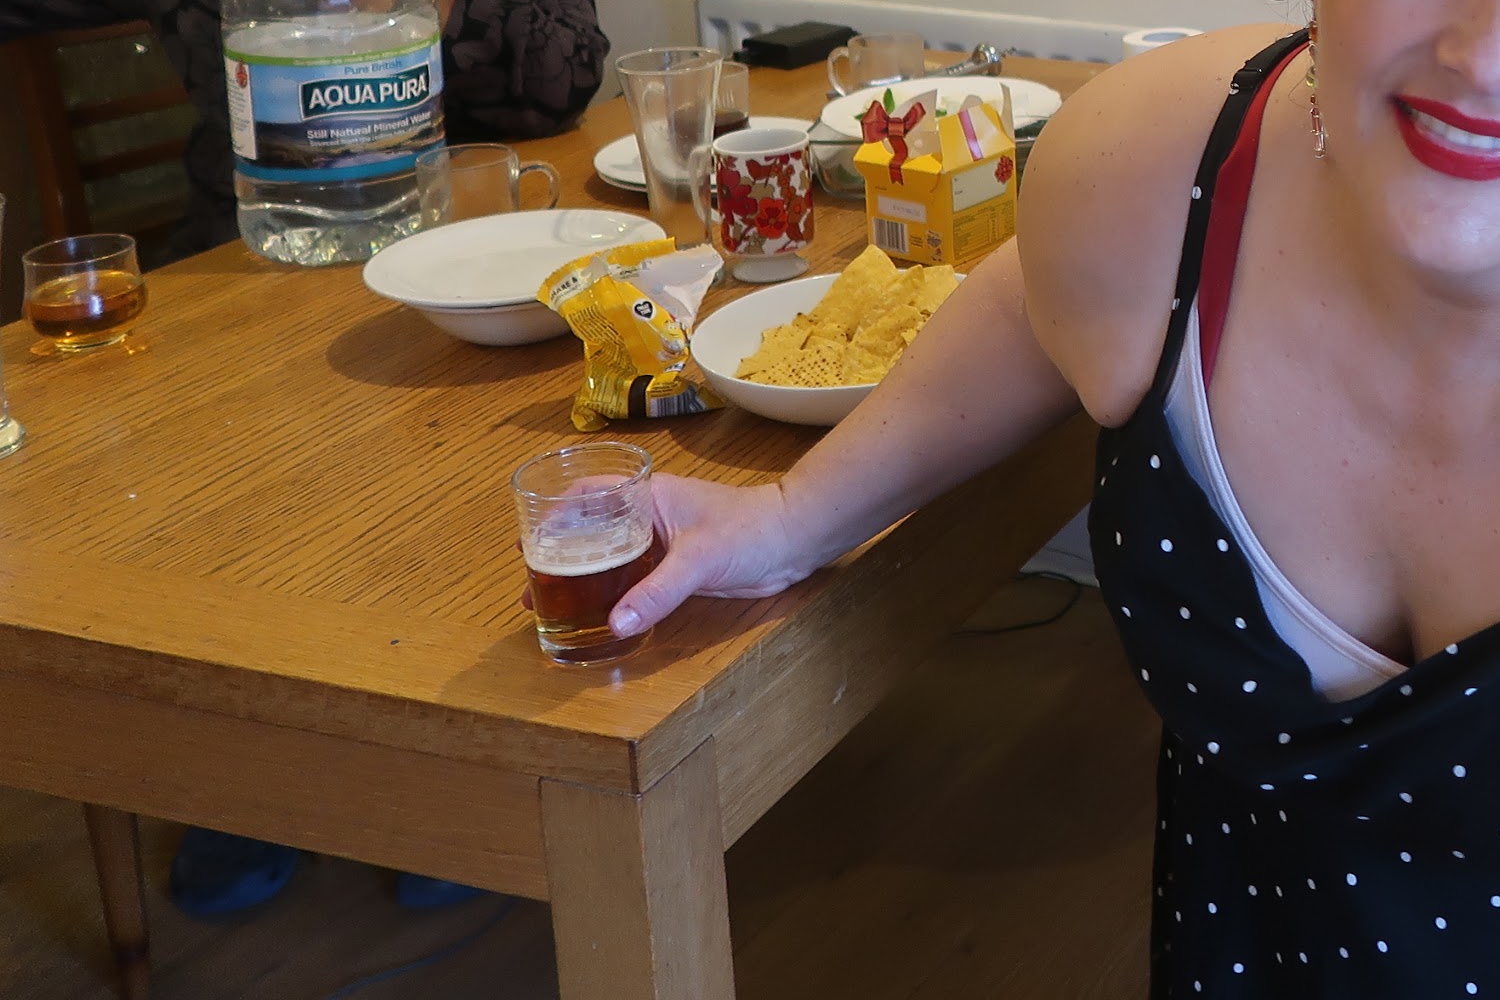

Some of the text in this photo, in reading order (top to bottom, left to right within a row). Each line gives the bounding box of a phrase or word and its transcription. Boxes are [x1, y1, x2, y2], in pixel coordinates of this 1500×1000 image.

[344, 65, 370, 76] Pure
[371, 59, 402, 72] British
[308, 73, 428, 110] AQUA PURA
[306, 129, 328, 139] Still
[330, 124, 371, 138] Natural
[373, 117, 409, 132] Mineral
[410, 111, 432, 124] Water
